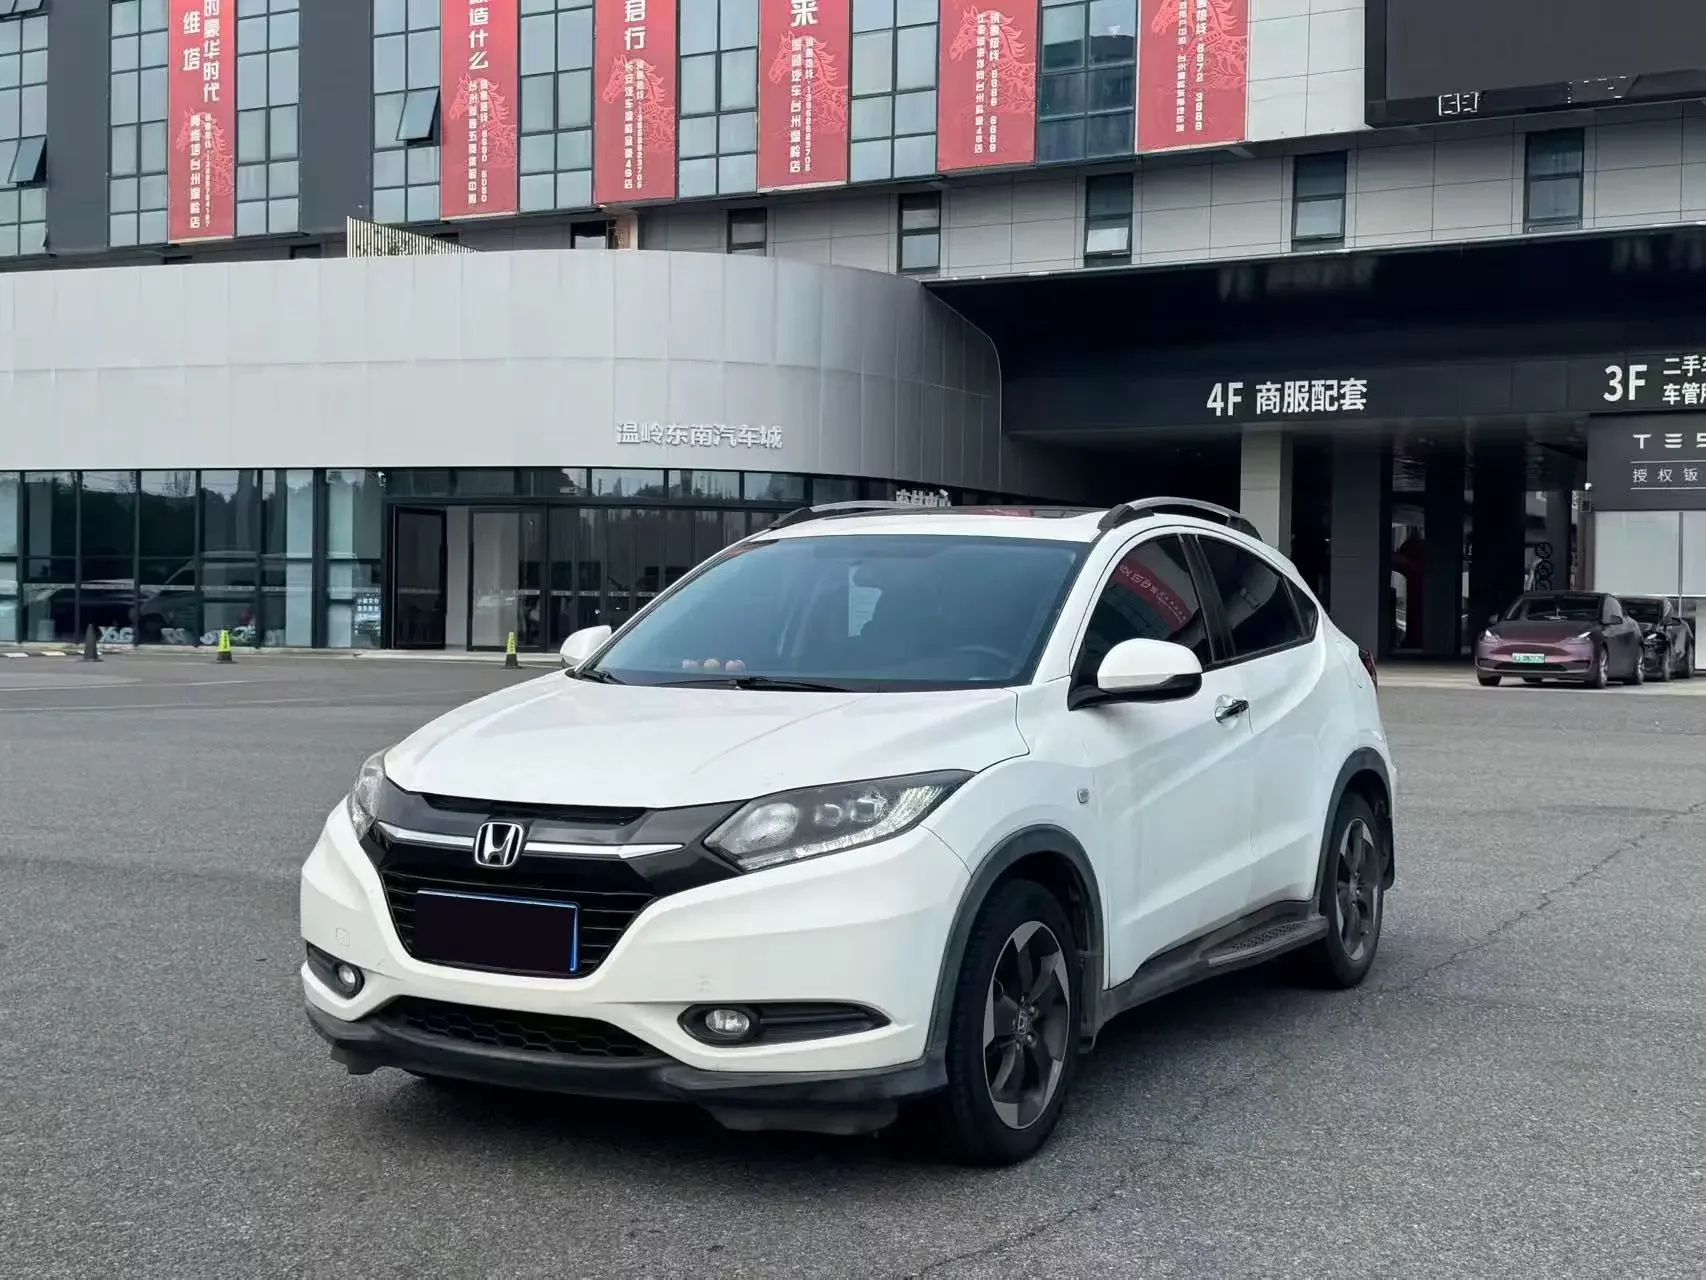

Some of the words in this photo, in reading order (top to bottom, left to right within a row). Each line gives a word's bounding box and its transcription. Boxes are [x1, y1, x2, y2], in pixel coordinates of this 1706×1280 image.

[183, 10, 201, 71] 维塔
[203, 0, 220, 103] 的豪华时代
[469, 0, 488, 70] 造什么
[1206, 382, 1244, 416] 4F
[1255, 377, 1368, 415] 商服配套
[1603, 364, 1648, 402] 3F
[616, 422, 784, 449] 温岭东南汽车城
[1633, 468, 1698, 483] 授权钣
